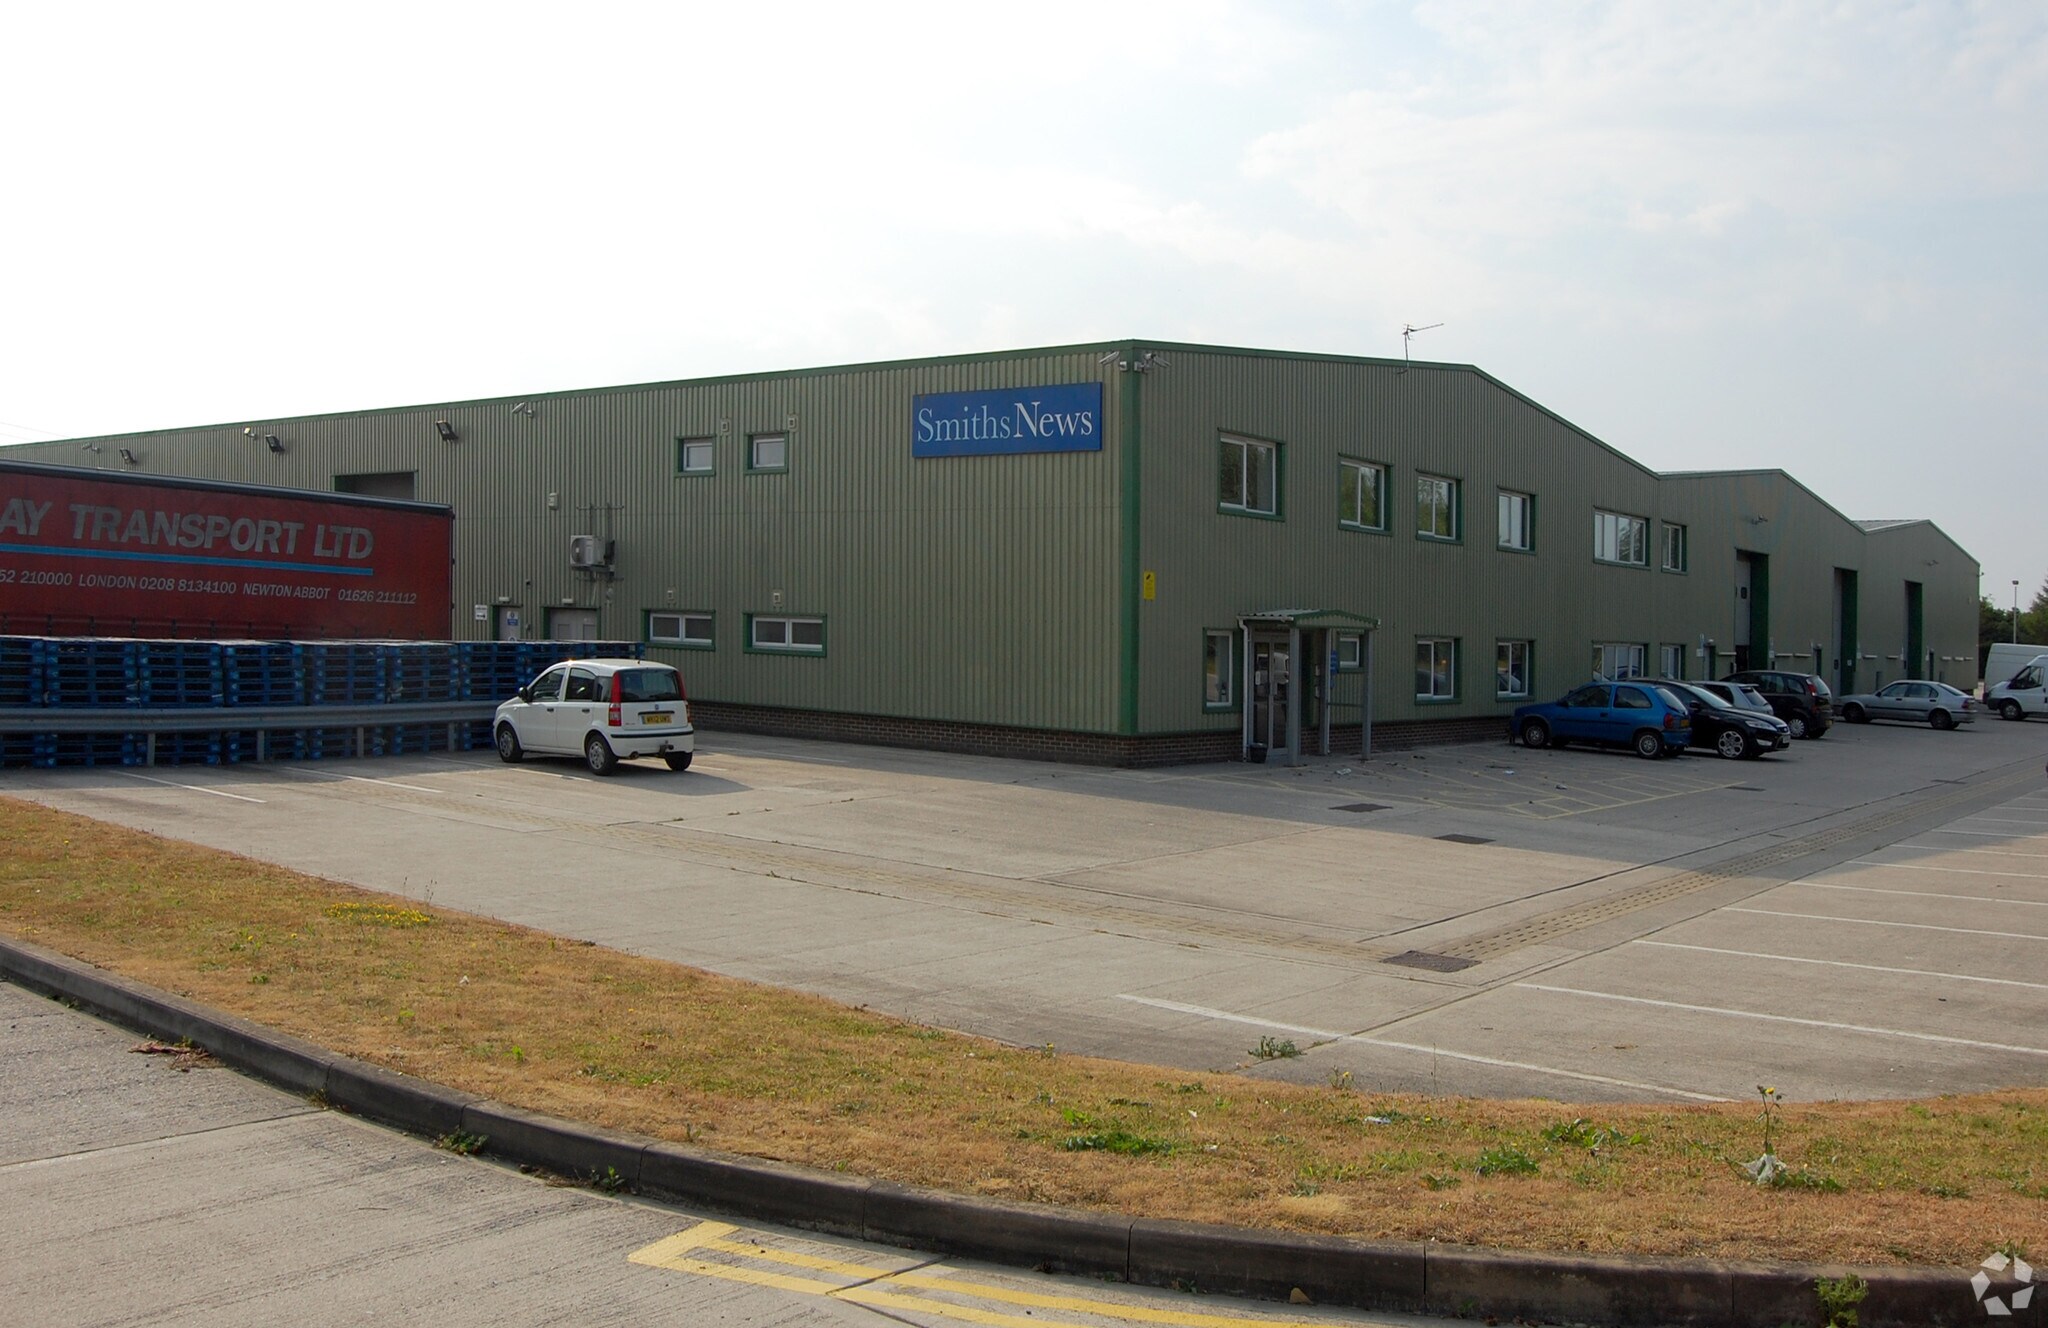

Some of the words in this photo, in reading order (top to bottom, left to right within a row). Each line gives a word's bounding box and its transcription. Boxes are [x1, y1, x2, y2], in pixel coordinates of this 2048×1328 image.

[69, 503, 304, 555] TRANSPORT
[314, 524, 375, 560] LTD
[20, 570, 73, 586] 210000
[79, 574, 136, 589] LONDON
[139, 576, 175, 591] 0208
[178, 579, 237, 594] 8134100
[243, 583, 292, 598] NEWTON
[293, 586, 331, 600] ABBOT
[338, 588, 375, 603] 01626
[376, 591, 418, 605] 211112
